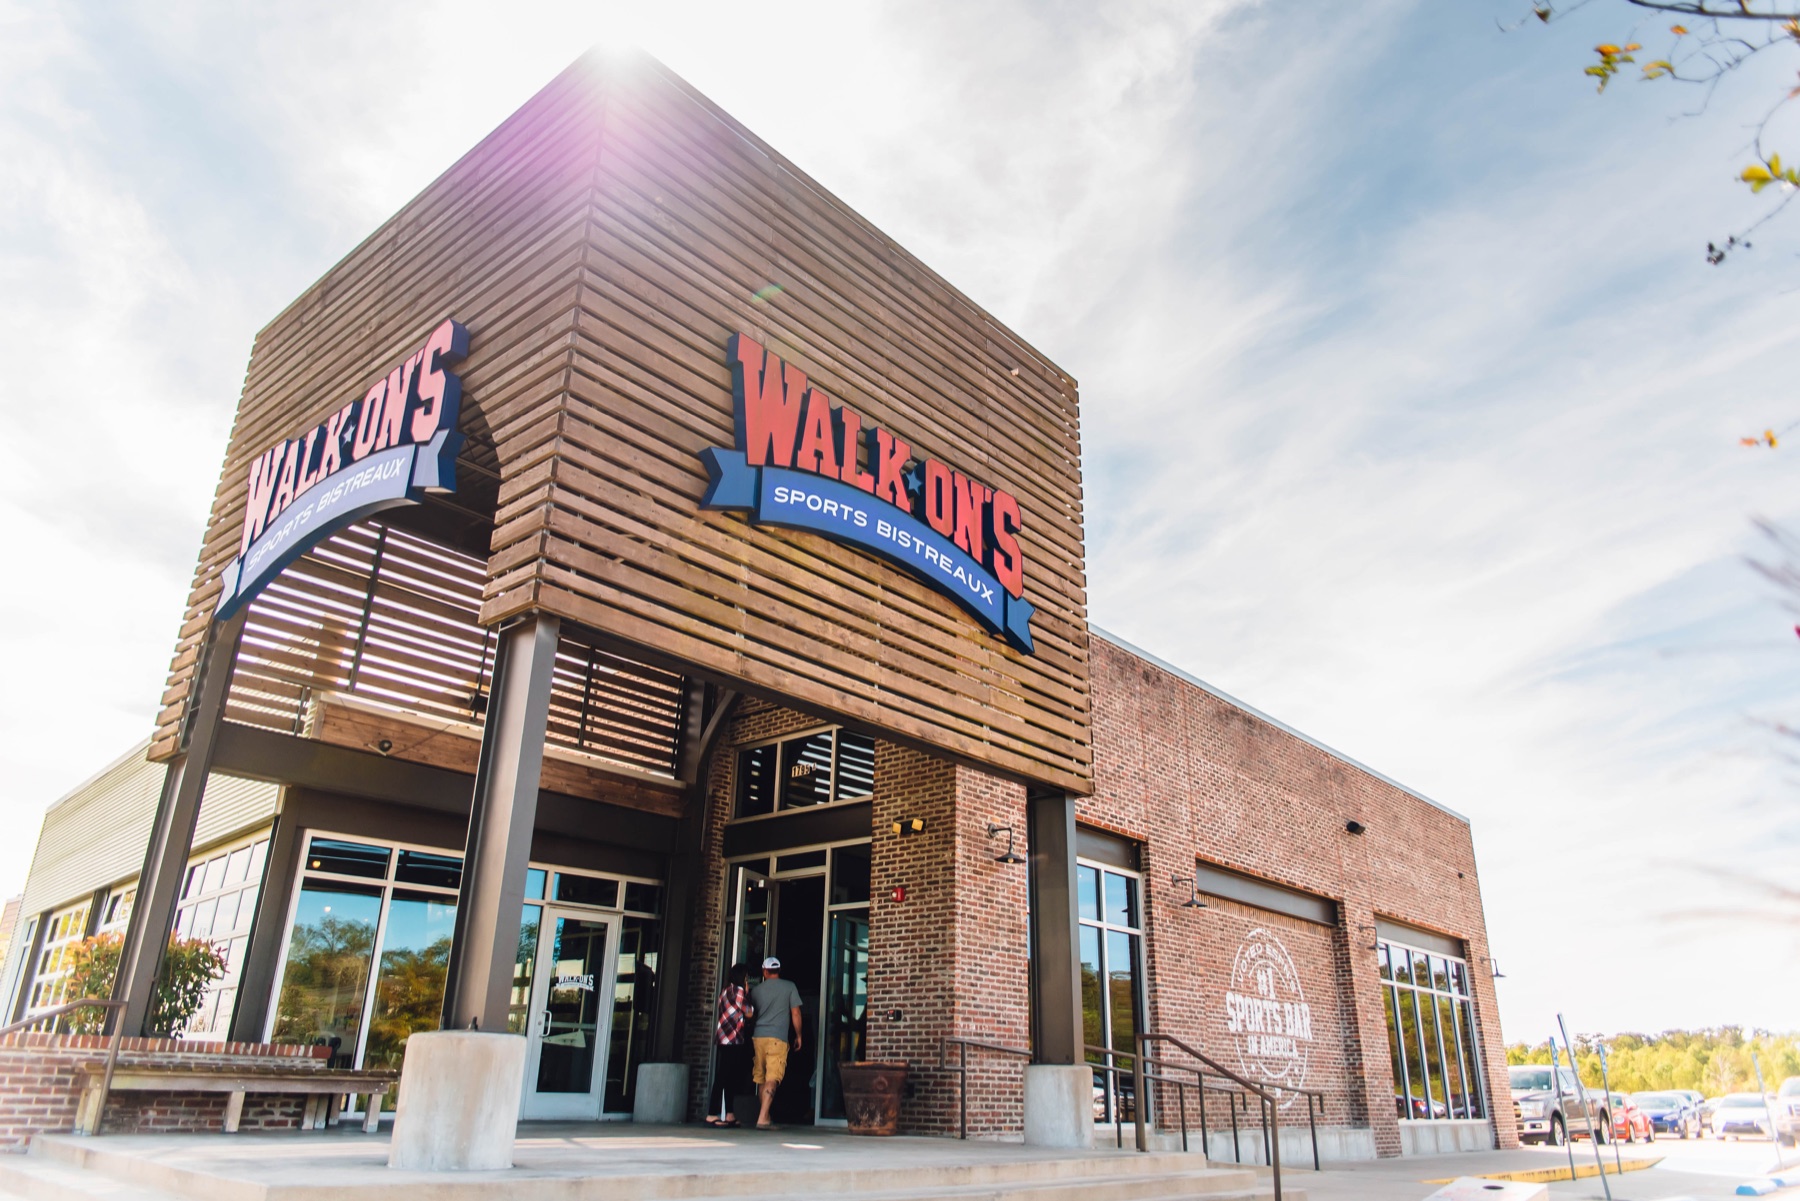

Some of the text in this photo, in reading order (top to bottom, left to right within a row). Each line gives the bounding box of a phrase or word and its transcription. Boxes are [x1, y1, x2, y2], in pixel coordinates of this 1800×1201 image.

[247, 457, 405, 572] SPORTS BISTREAUX
[774, 487, 994, 605] SPORTS BISTREAUX
[1237, 943, 1263, 982] VOTED
[1257, 967, 1276, 999] #1
[1226, 991, 1313, 1040] SPORTS BAR
[1247, 1035, 1299, 1058] IN AMERICA
